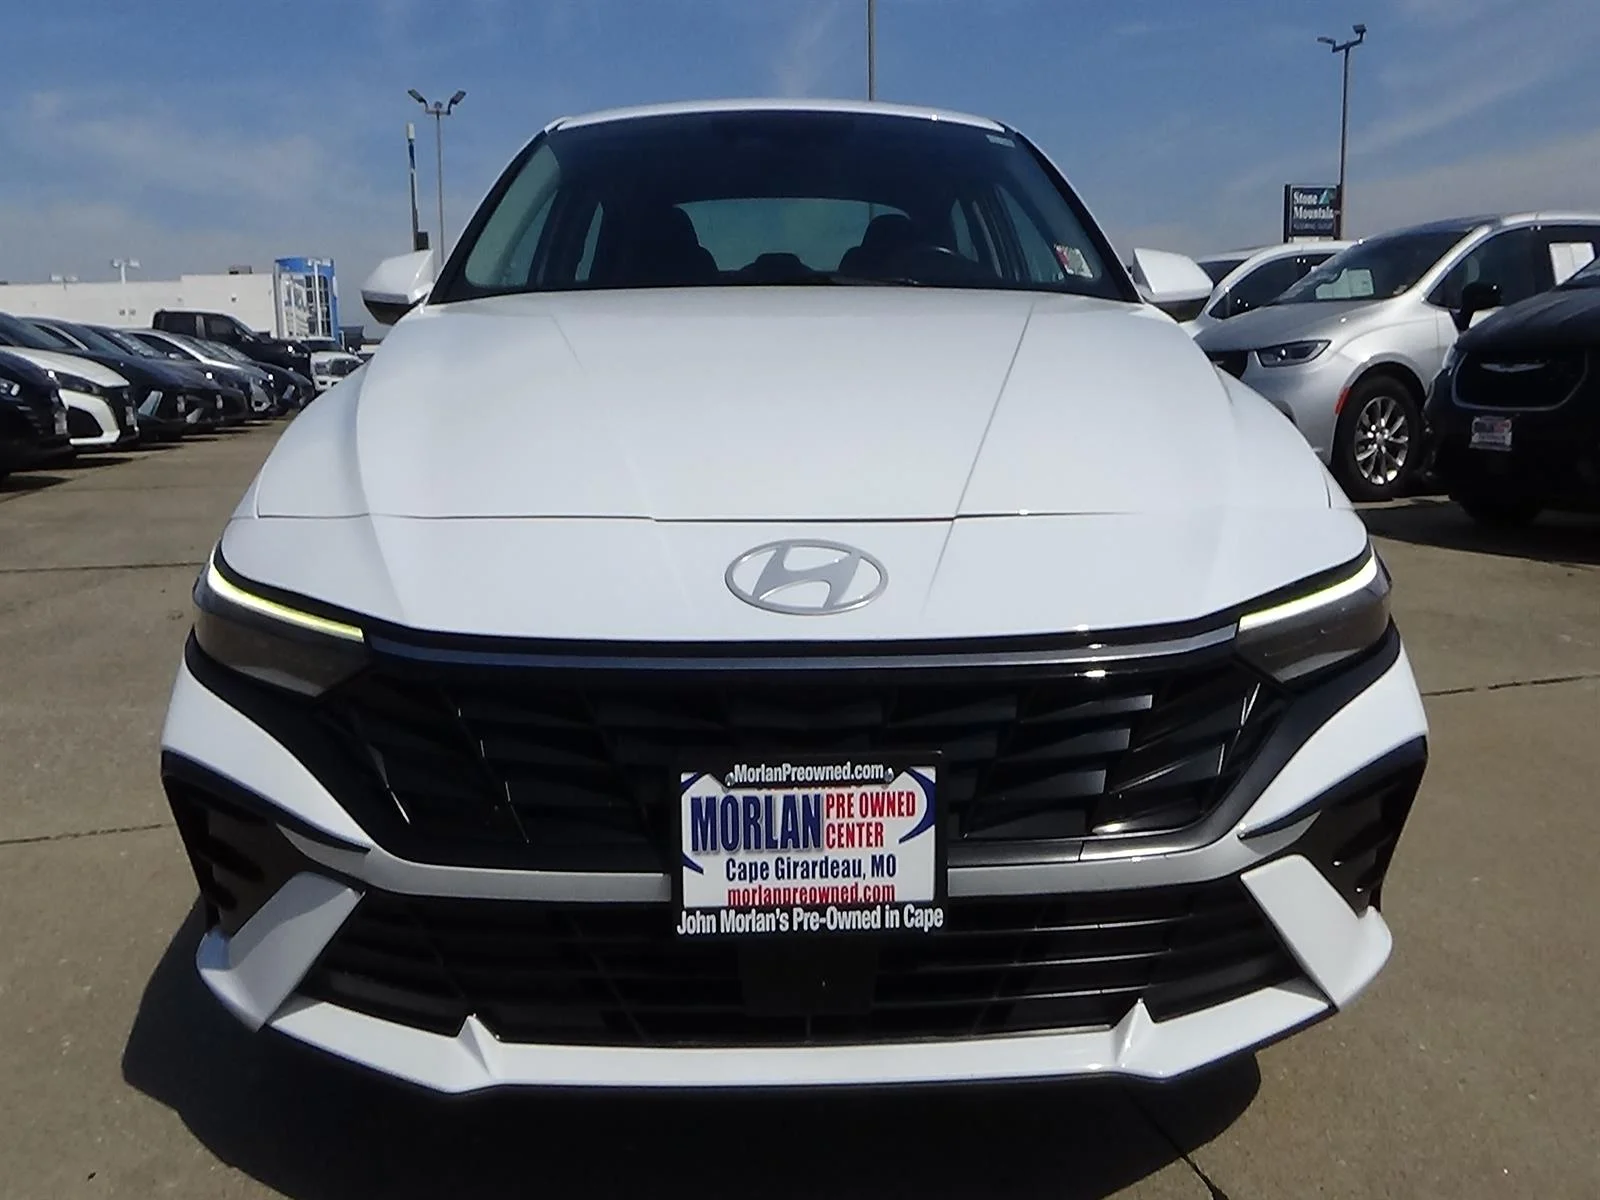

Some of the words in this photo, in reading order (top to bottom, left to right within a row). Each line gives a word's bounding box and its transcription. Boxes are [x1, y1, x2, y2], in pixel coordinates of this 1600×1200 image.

[733, 762, 884, 783] MorlanPreowned.com
[825, 793, 854, 819] PRE
[859, 791, 916, 818] OWNED
[691, 793, 822, 851] MORLAN
[825, 823, 884, 849] CENTER
[726, 858, 770, 882] Cape
[774, 856, 866, 880] Girardeau,
[871, 853, 897, 878] MO
[677, 910, 717, 935] John
[720, 908, 789, 933] Morlan's
[793, 905, 880, 931] Pre-Owned
[885, 904, 900, 929] in
[903, 903, 944, 932] Cape
